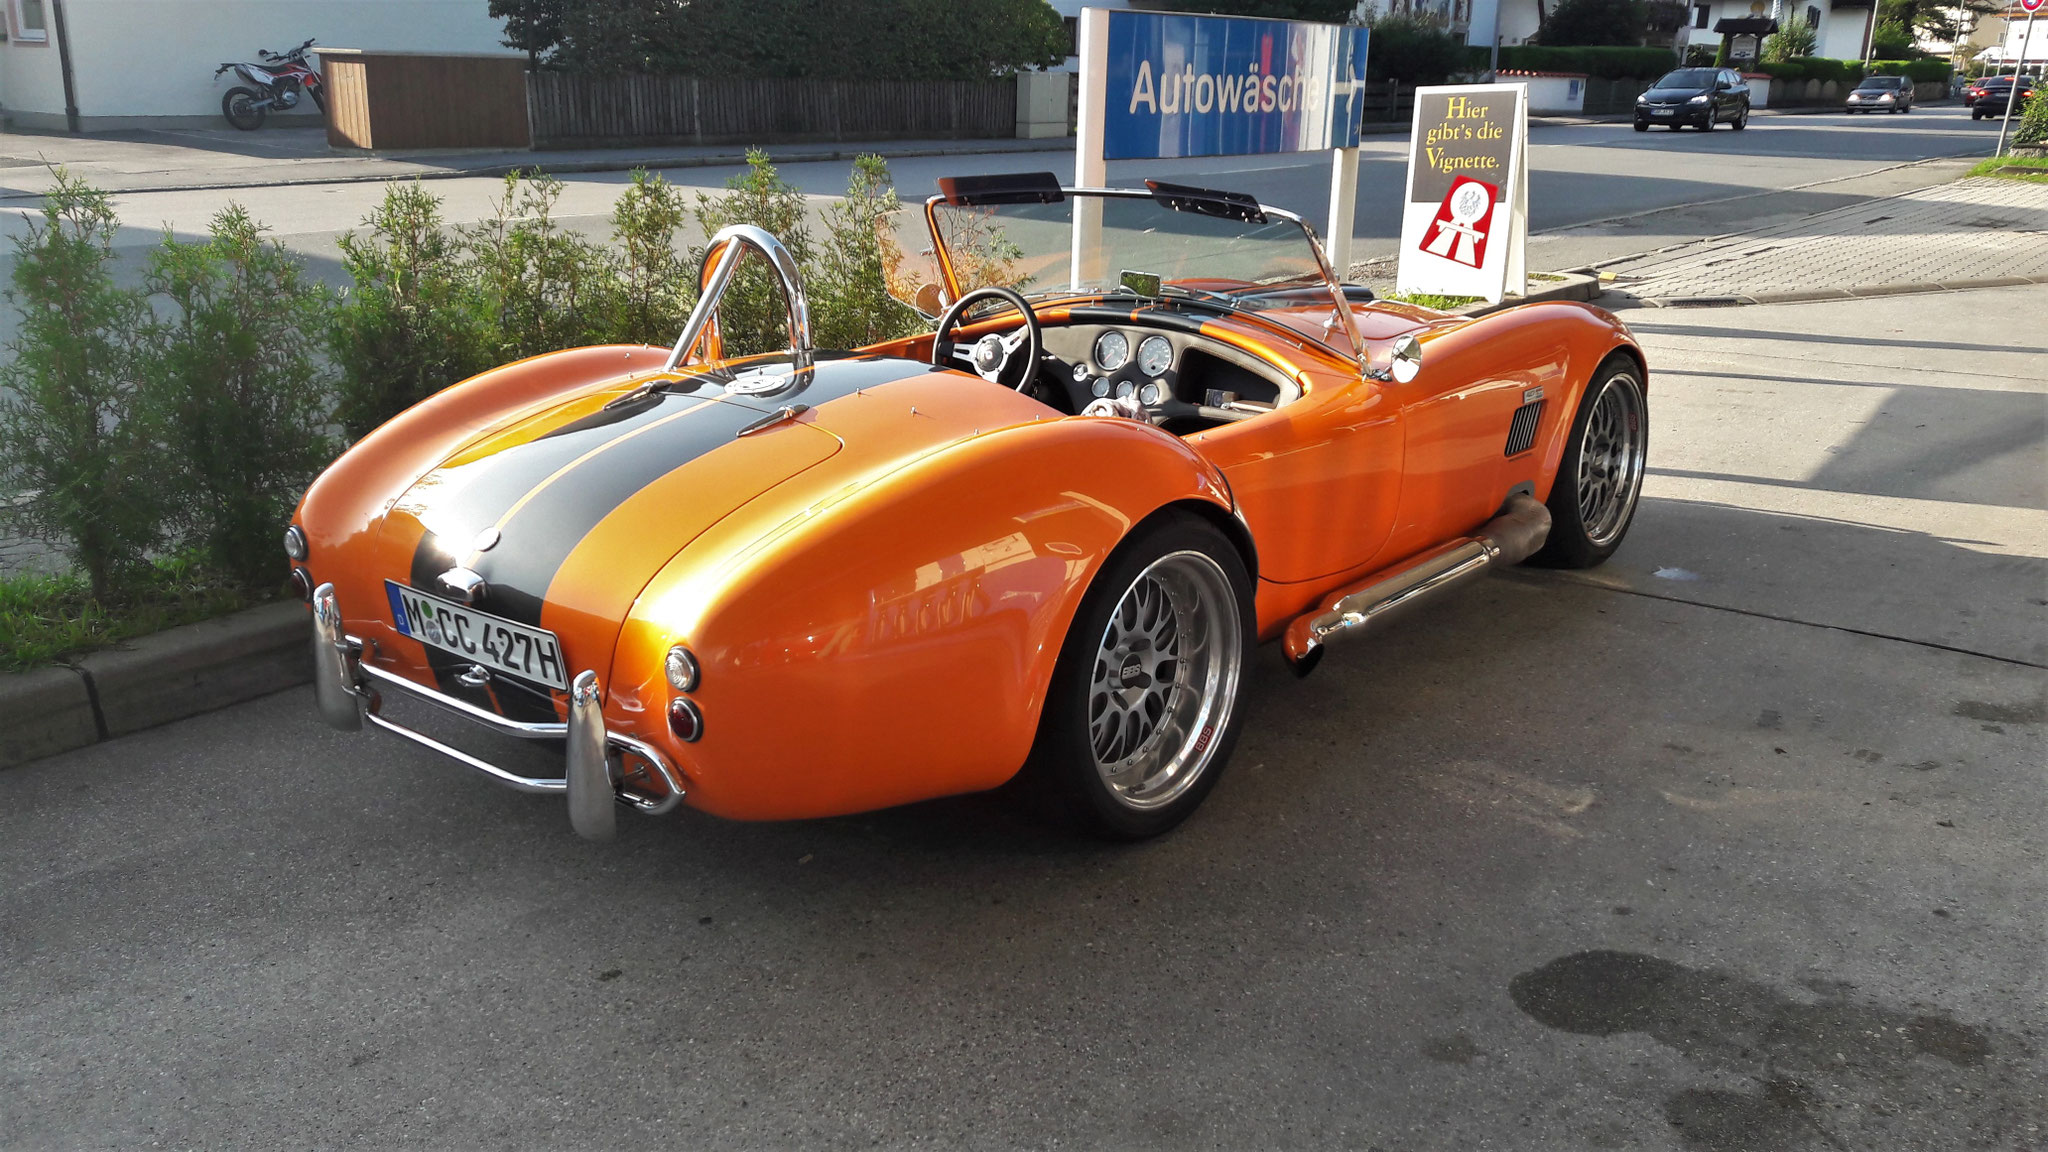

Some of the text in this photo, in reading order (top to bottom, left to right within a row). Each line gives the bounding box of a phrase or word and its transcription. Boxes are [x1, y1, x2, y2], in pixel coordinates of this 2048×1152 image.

[1129, 60, 1320, 114] Autowäsche
[1446, 96, 1489, 119] Hier
[1426, 121, 1503, 146] gibt's die
[1425, 147, 1500, 173] Vignette.
[402, 594, 562, 683] M CC 427H
[1121, 663, 1141, 680] BBS
[1195, 726, 1212, 752] BBS
